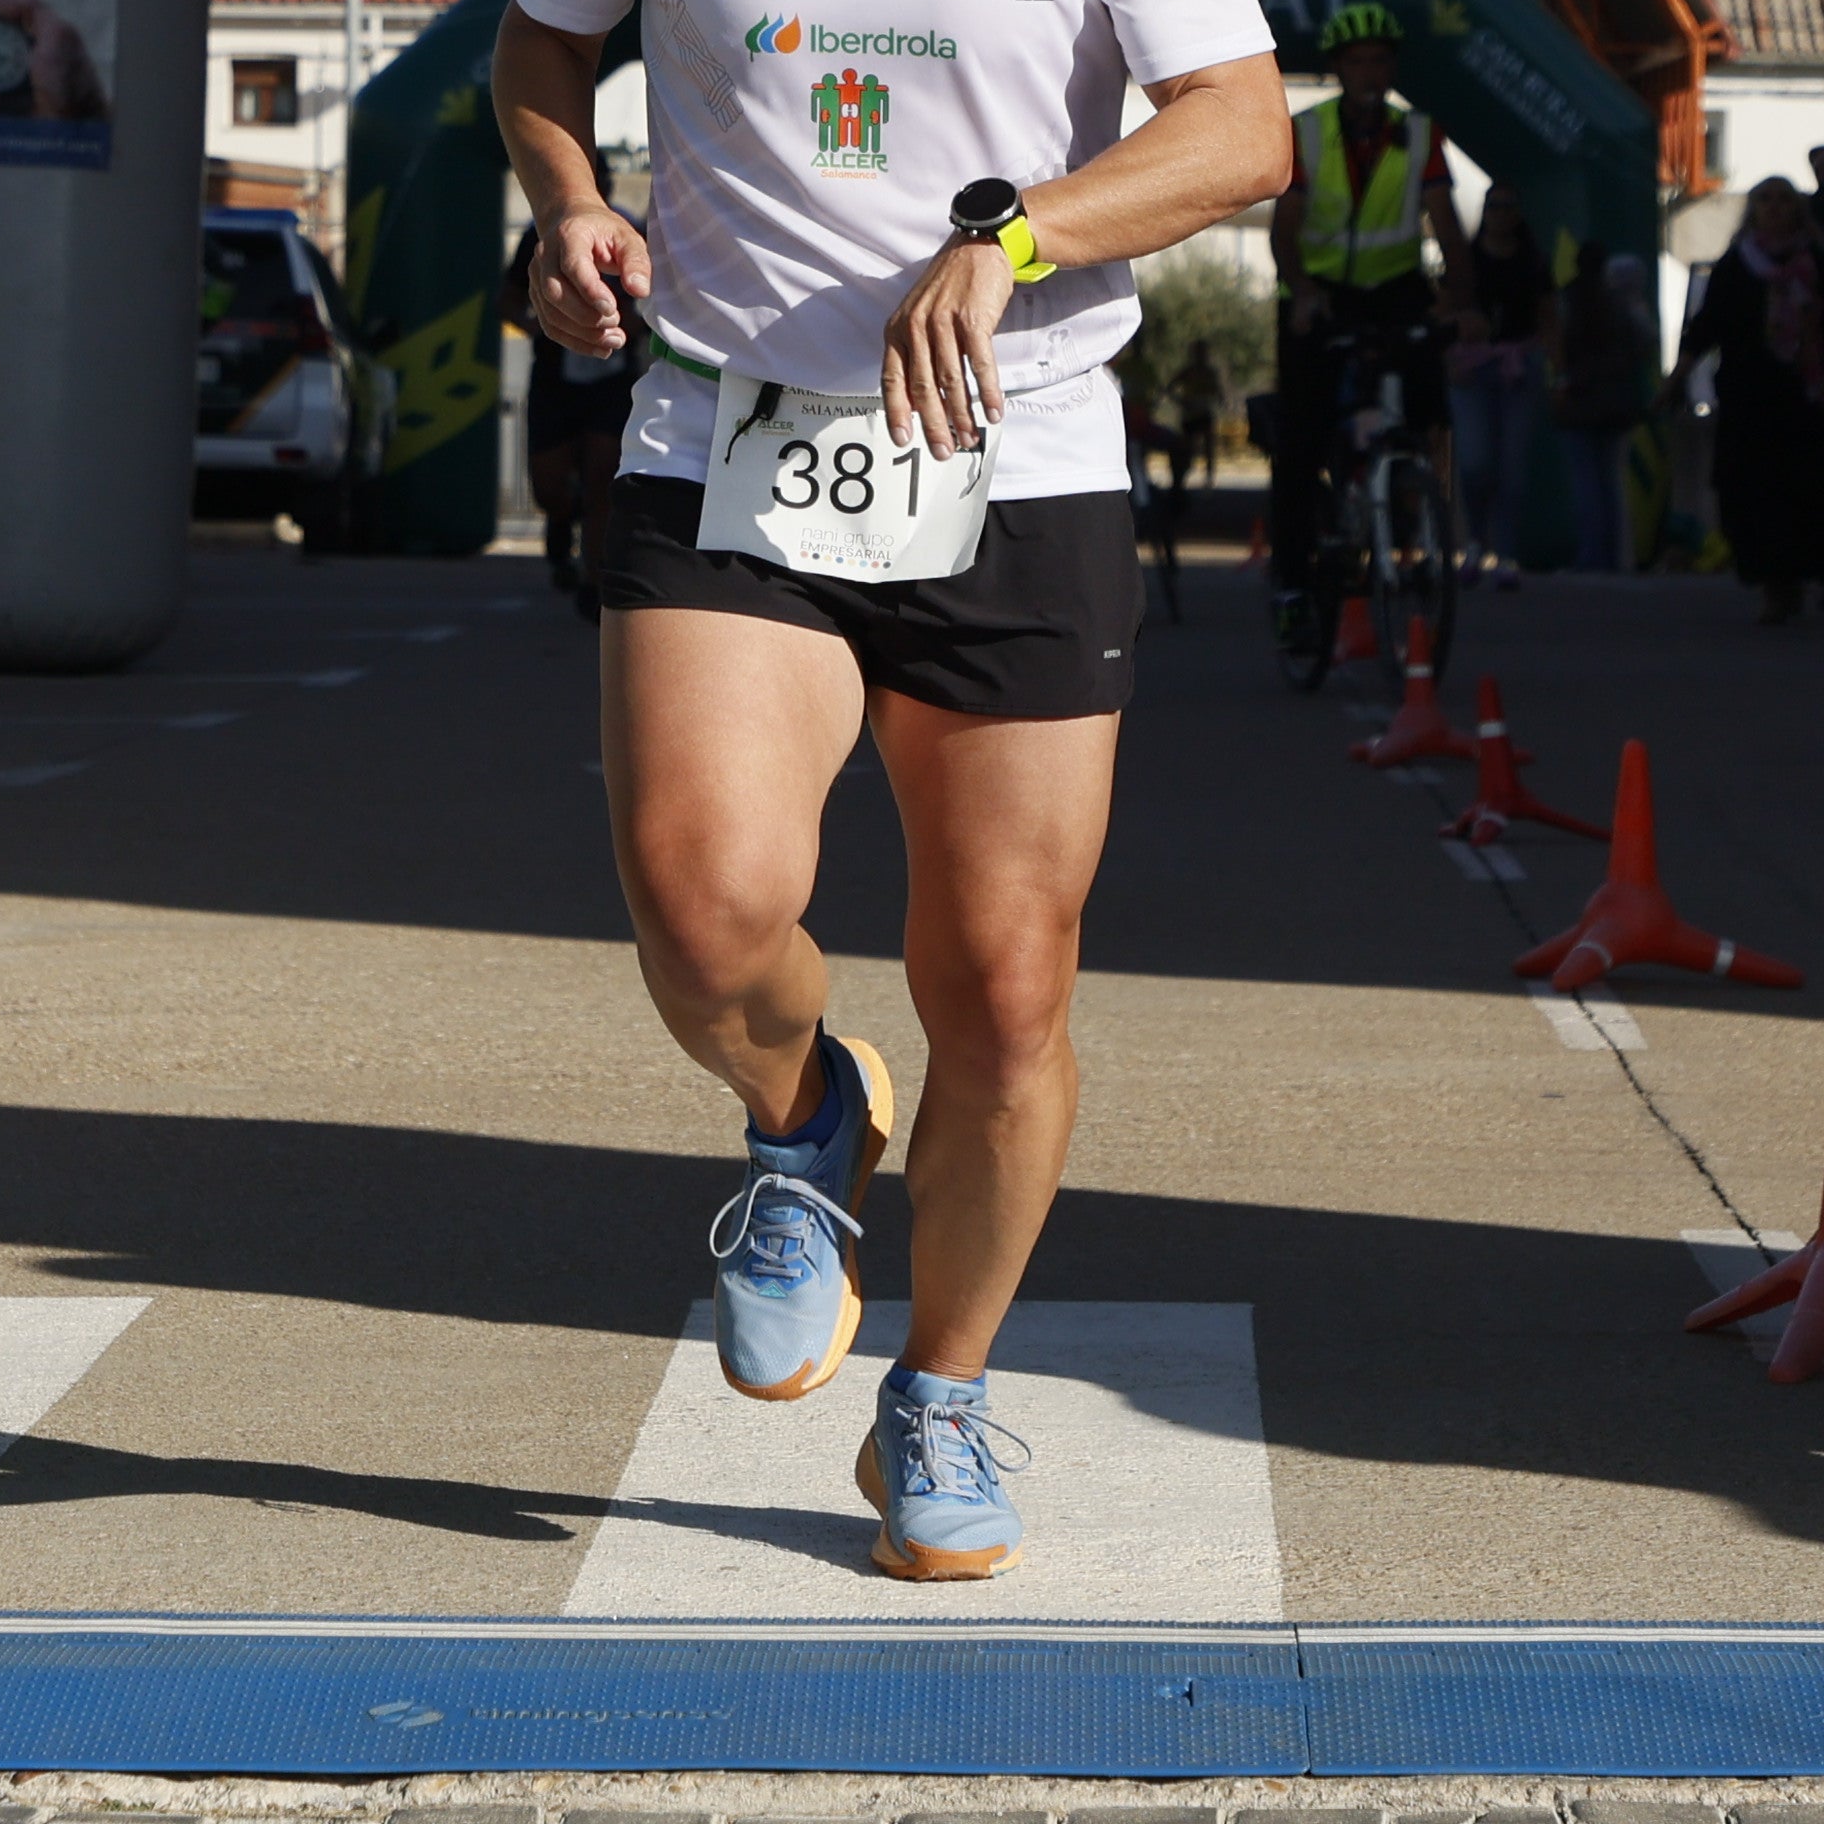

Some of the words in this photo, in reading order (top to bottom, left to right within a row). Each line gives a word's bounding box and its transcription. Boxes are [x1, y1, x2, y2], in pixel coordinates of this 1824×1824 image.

[810, 23, 958, 60] Iberdrola
[811, 151, 890, 173] ALCER
[820, 169, 878, 180] Salamanca
[771, 439, 922, 518] 381
[801, 526, 839, 543] nani
[844, 531, 895, 550] grupo
[800, 539, 892, 561] EMPRESARIAL
